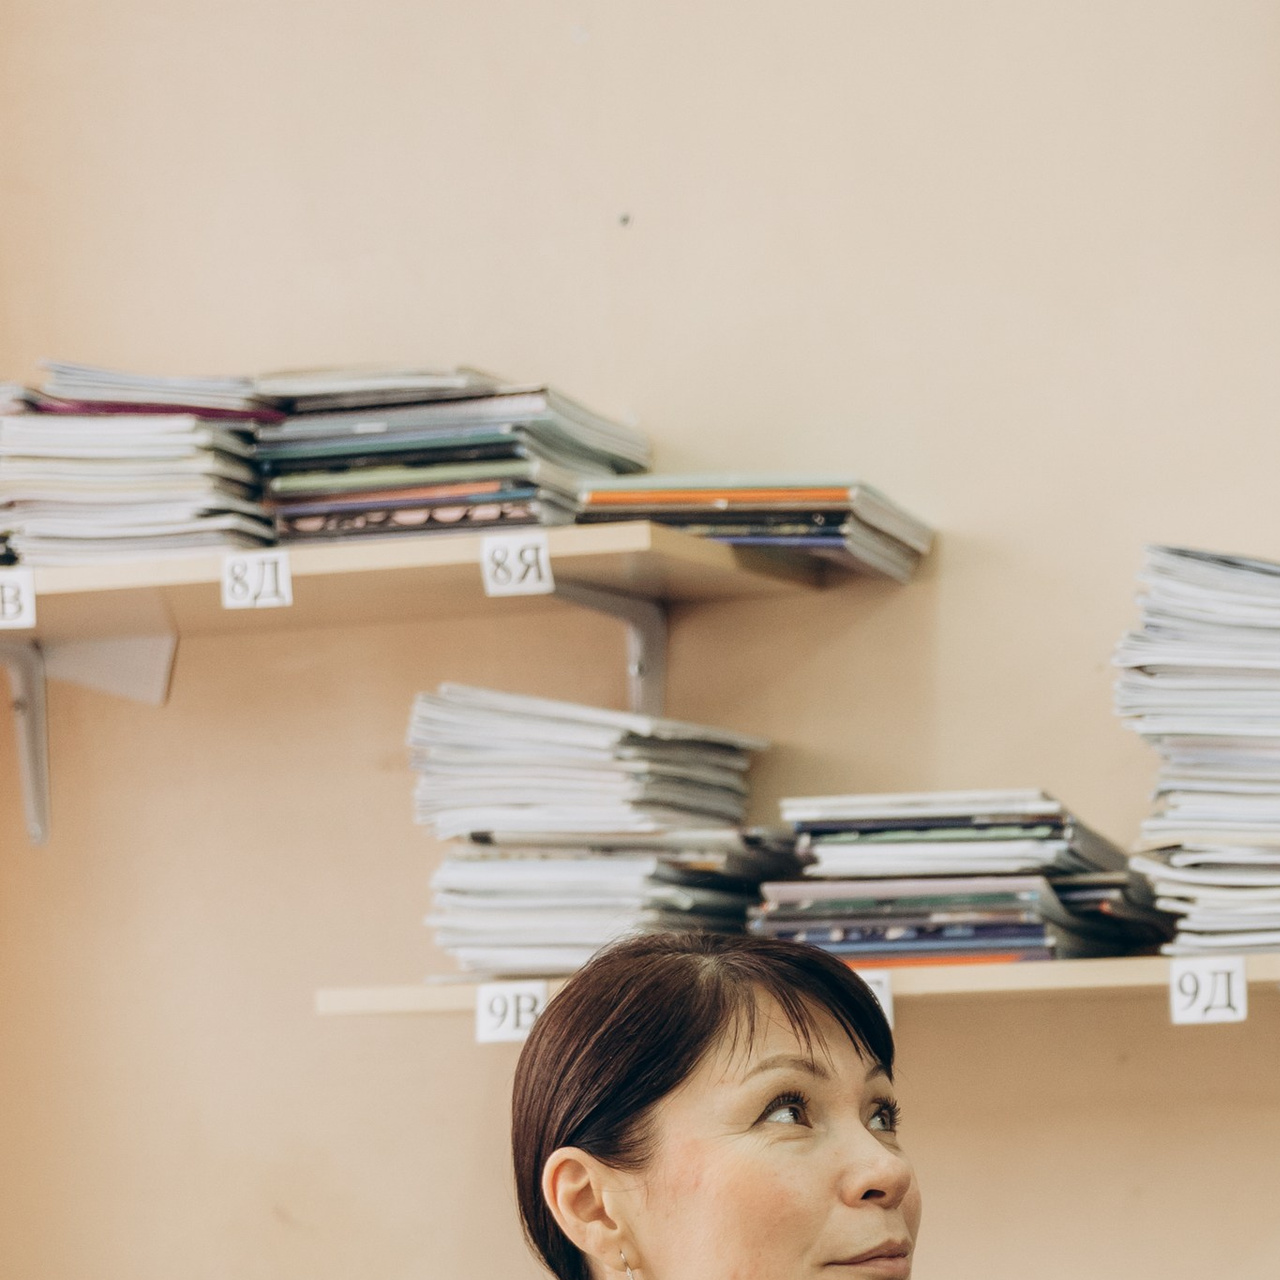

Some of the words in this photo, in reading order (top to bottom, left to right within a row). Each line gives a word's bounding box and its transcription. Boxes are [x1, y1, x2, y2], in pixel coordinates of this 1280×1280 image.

[226, 557, 289, 605] 8Д
[488, 543, 551, 589] 8Я
[0, 584, 24, 620] В
[1177, 969, 1238, 1017] 9Д
